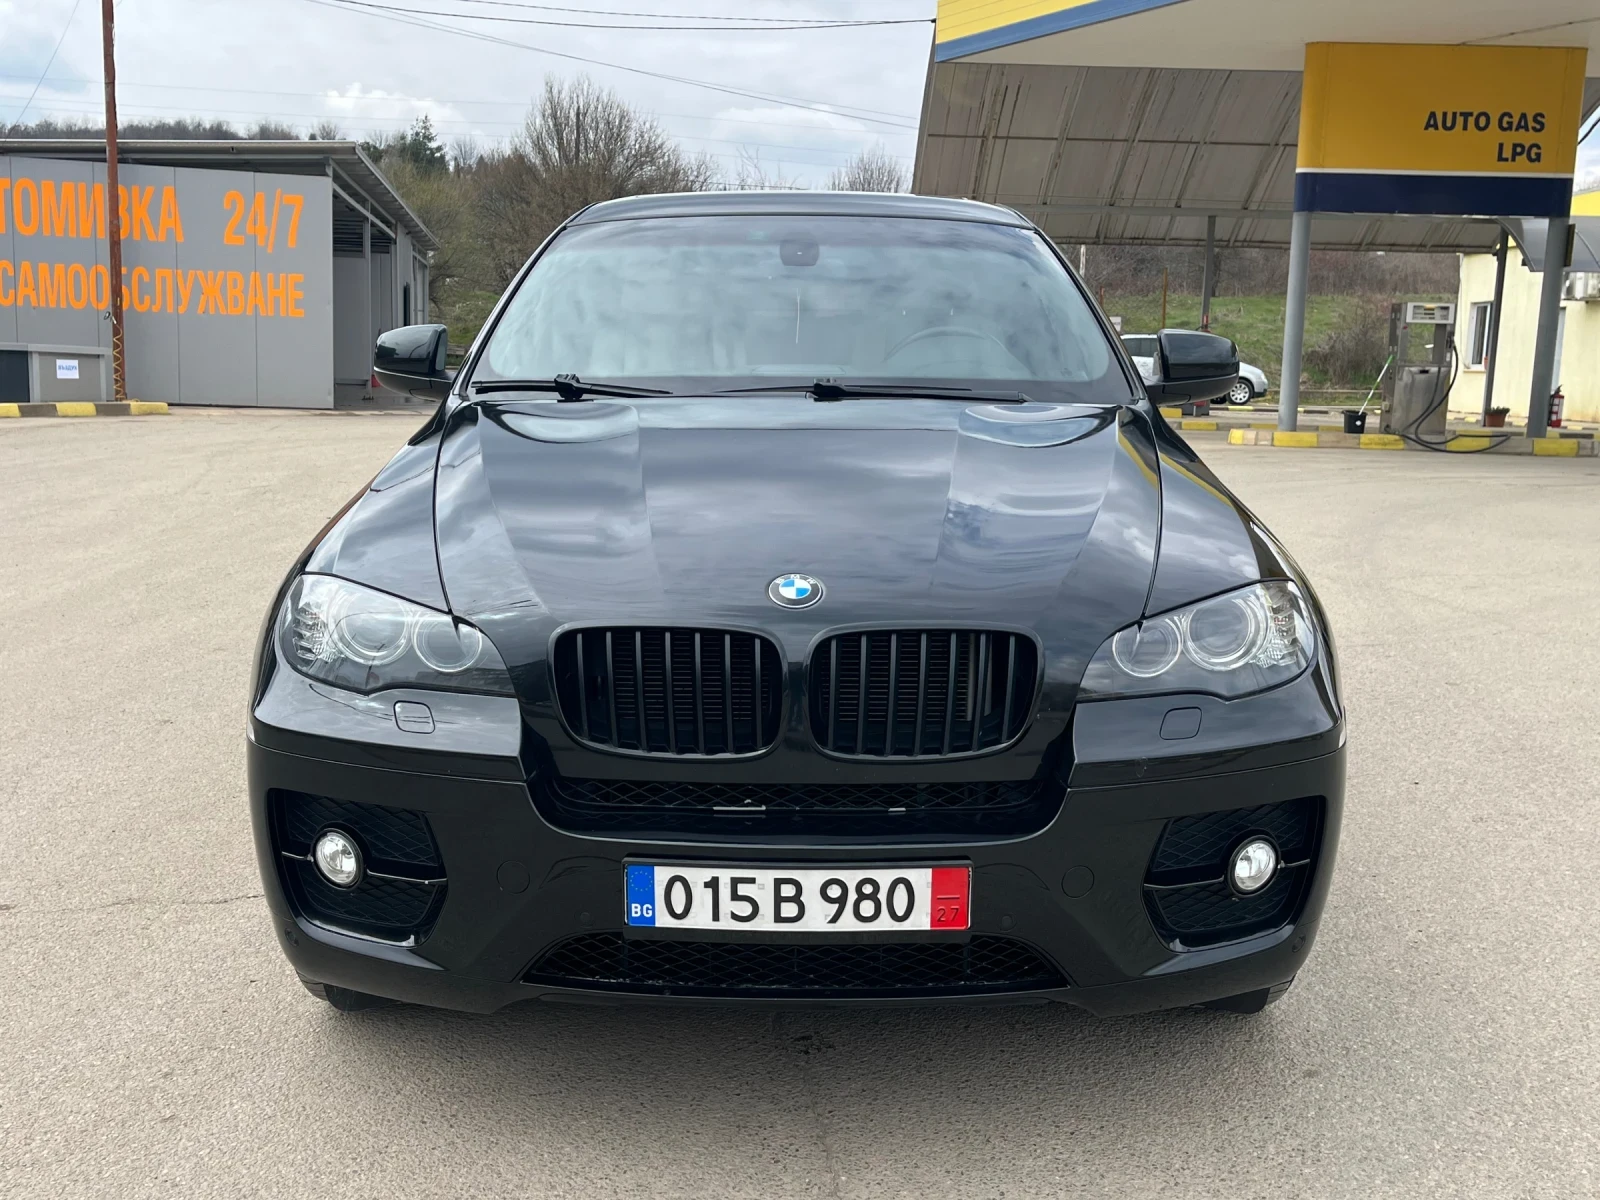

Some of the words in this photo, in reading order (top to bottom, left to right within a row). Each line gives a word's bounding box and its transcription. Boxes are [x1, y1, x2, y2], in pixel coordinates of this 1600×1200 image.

[1424, 111, 1491, 132] AUTO
[1497, 112, 1545, 132] GAS
[1496, 142, 1542, 163] LPG
[223, 188, 304, 253] 24/7
[664, 874, 760, 923] 015
[773, 877, 805, 923] B
[819, 877, 915, 924] 980
[631, 903, 653, 917] BG
[936, 906, 960, 922] 27
